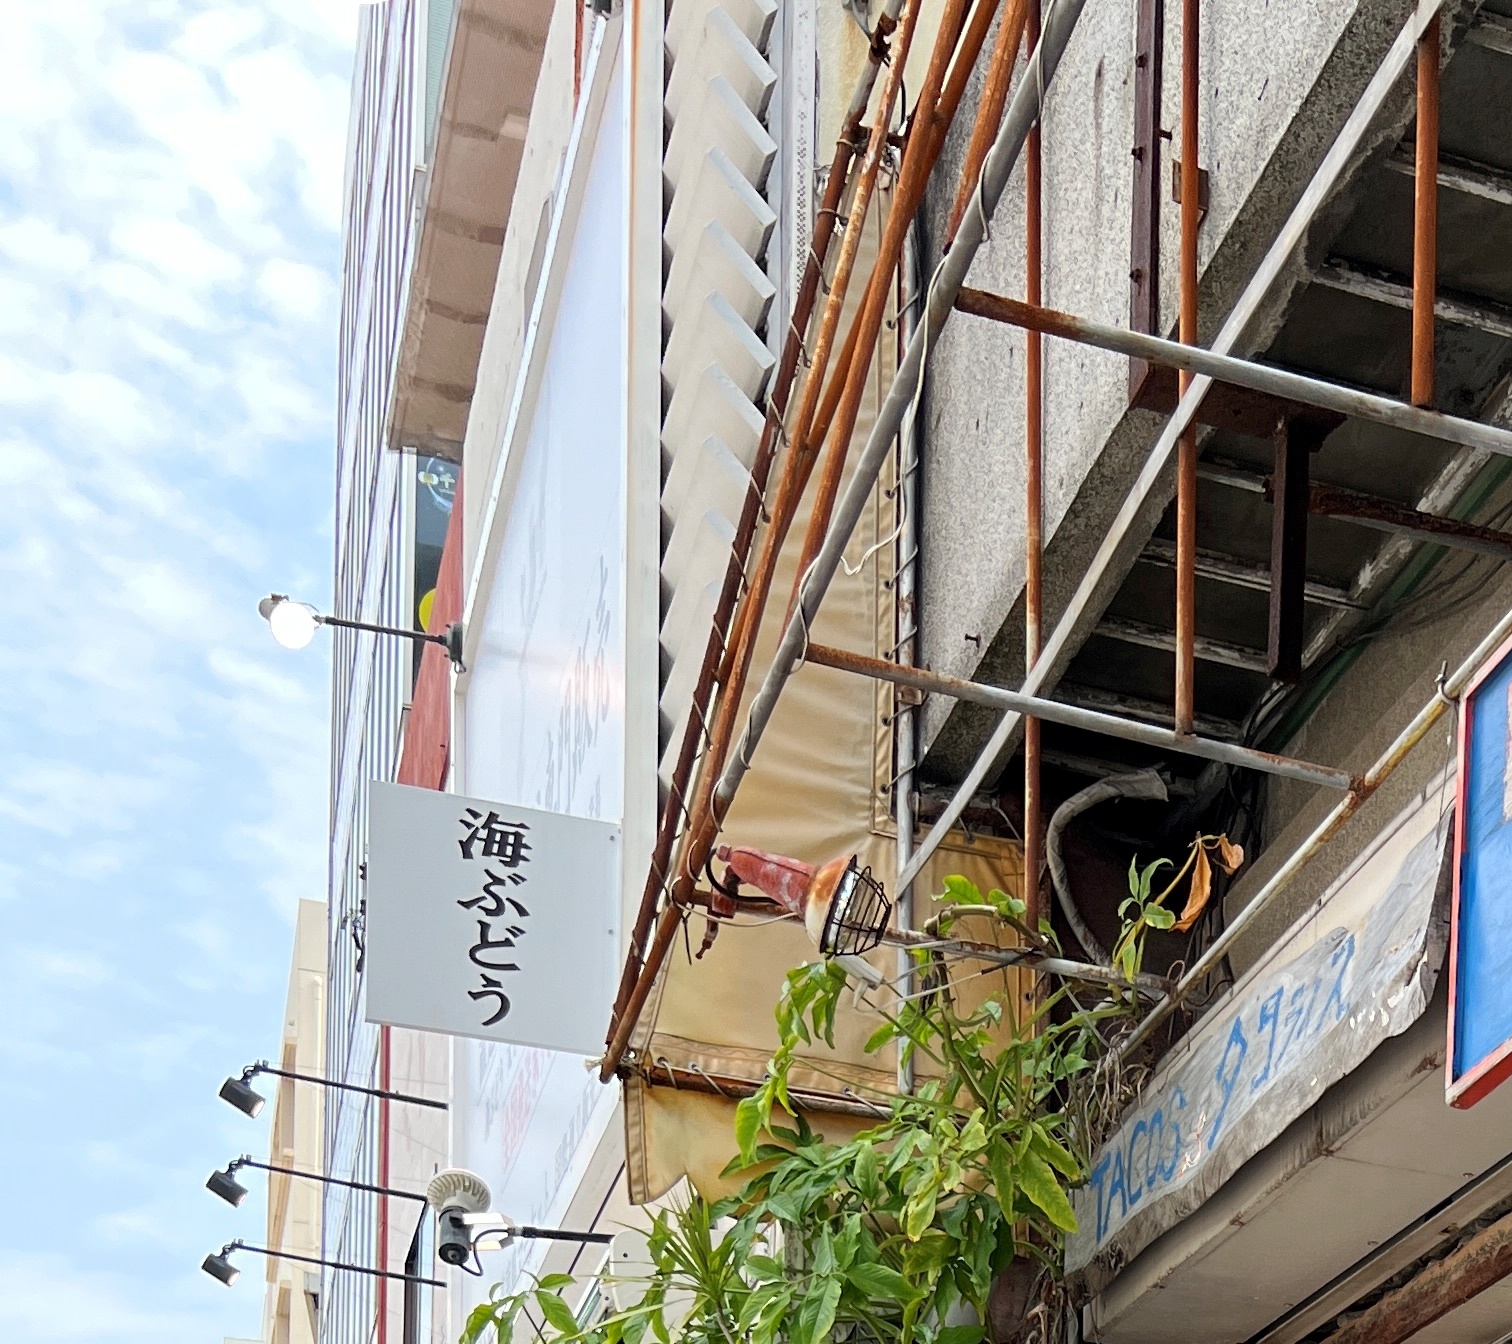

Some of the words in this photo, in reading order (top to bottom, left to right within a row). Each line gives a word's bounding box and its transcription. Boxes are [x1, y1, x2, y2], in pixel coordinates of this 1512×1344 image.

[457, 807, 533, 1027] 海ぶどう
[1089, 1086, 1188, 1244] TACOS
